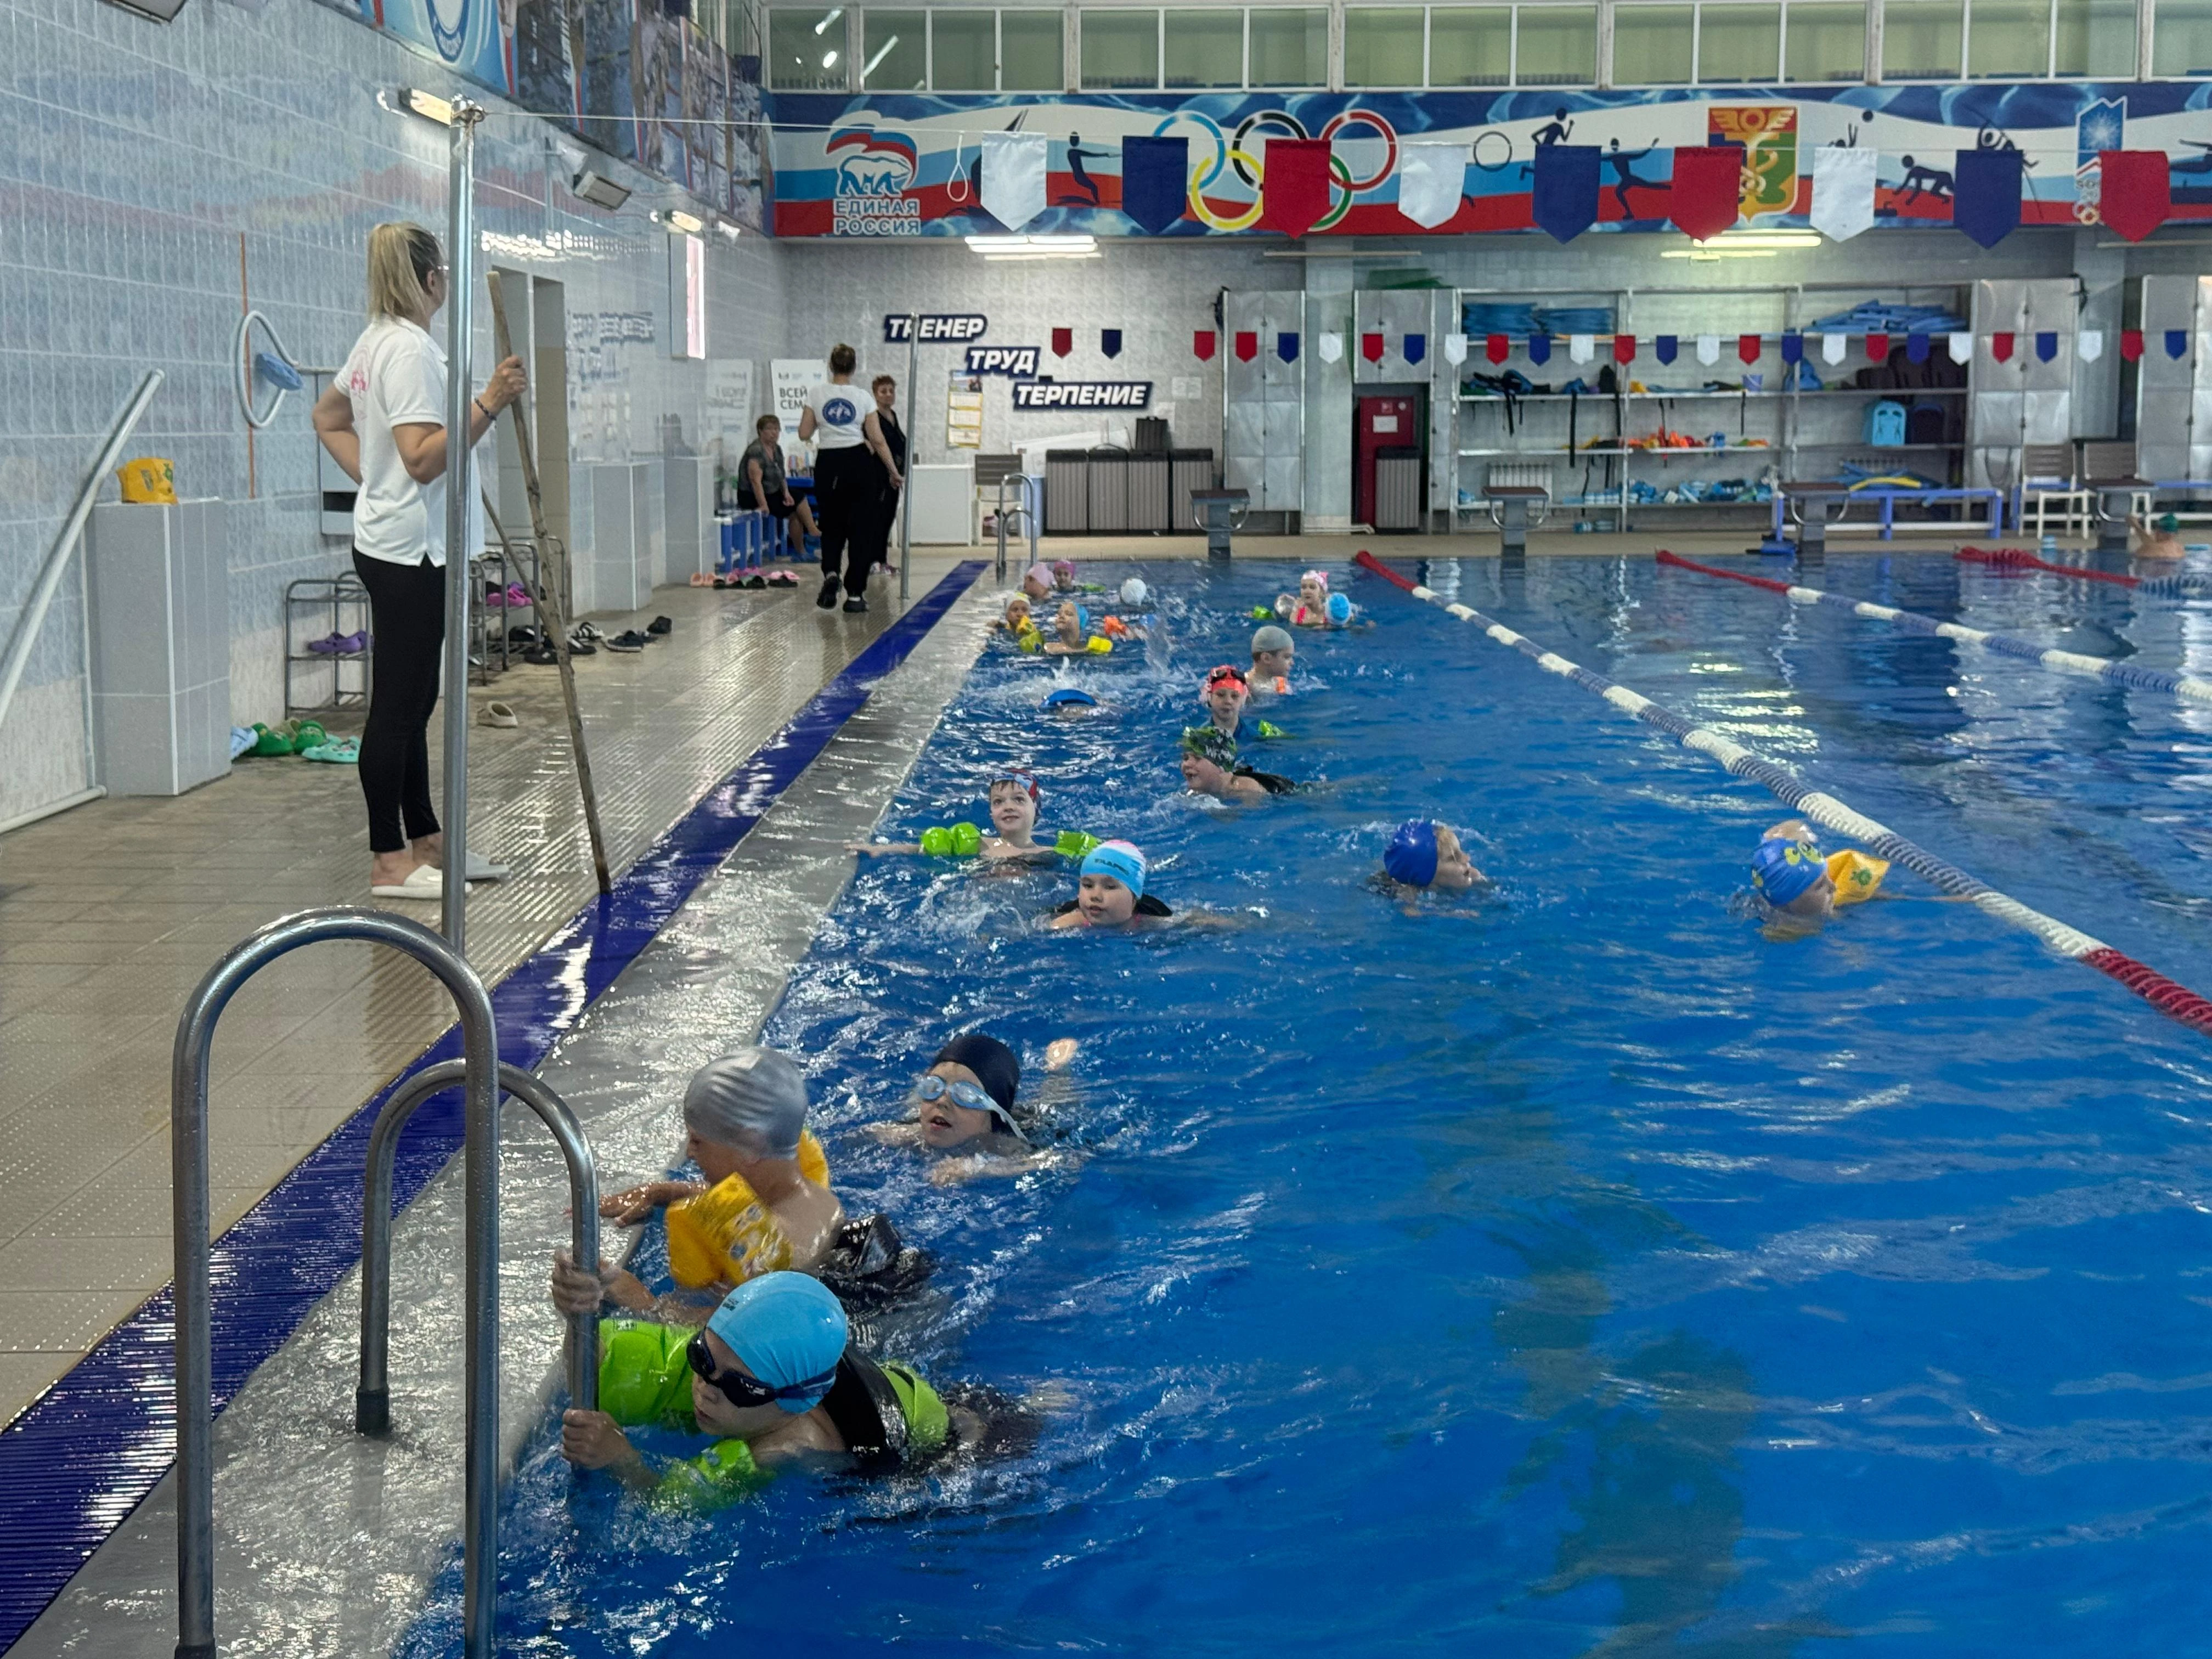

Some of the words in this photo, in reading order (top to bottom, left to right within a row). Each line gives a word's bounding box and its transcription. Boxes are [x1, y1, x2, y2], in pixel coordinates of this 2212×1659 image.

[835, 199, 919, 217] ЕДИНАЯ
[835, 218, 920, 234] РОССИЯ
[970, 349, 1036, 374] ТРУД
[1017, 385, 1147, 405] ТЕРПЕНИЕ
[780, 399, 804, 410] СЕМ
